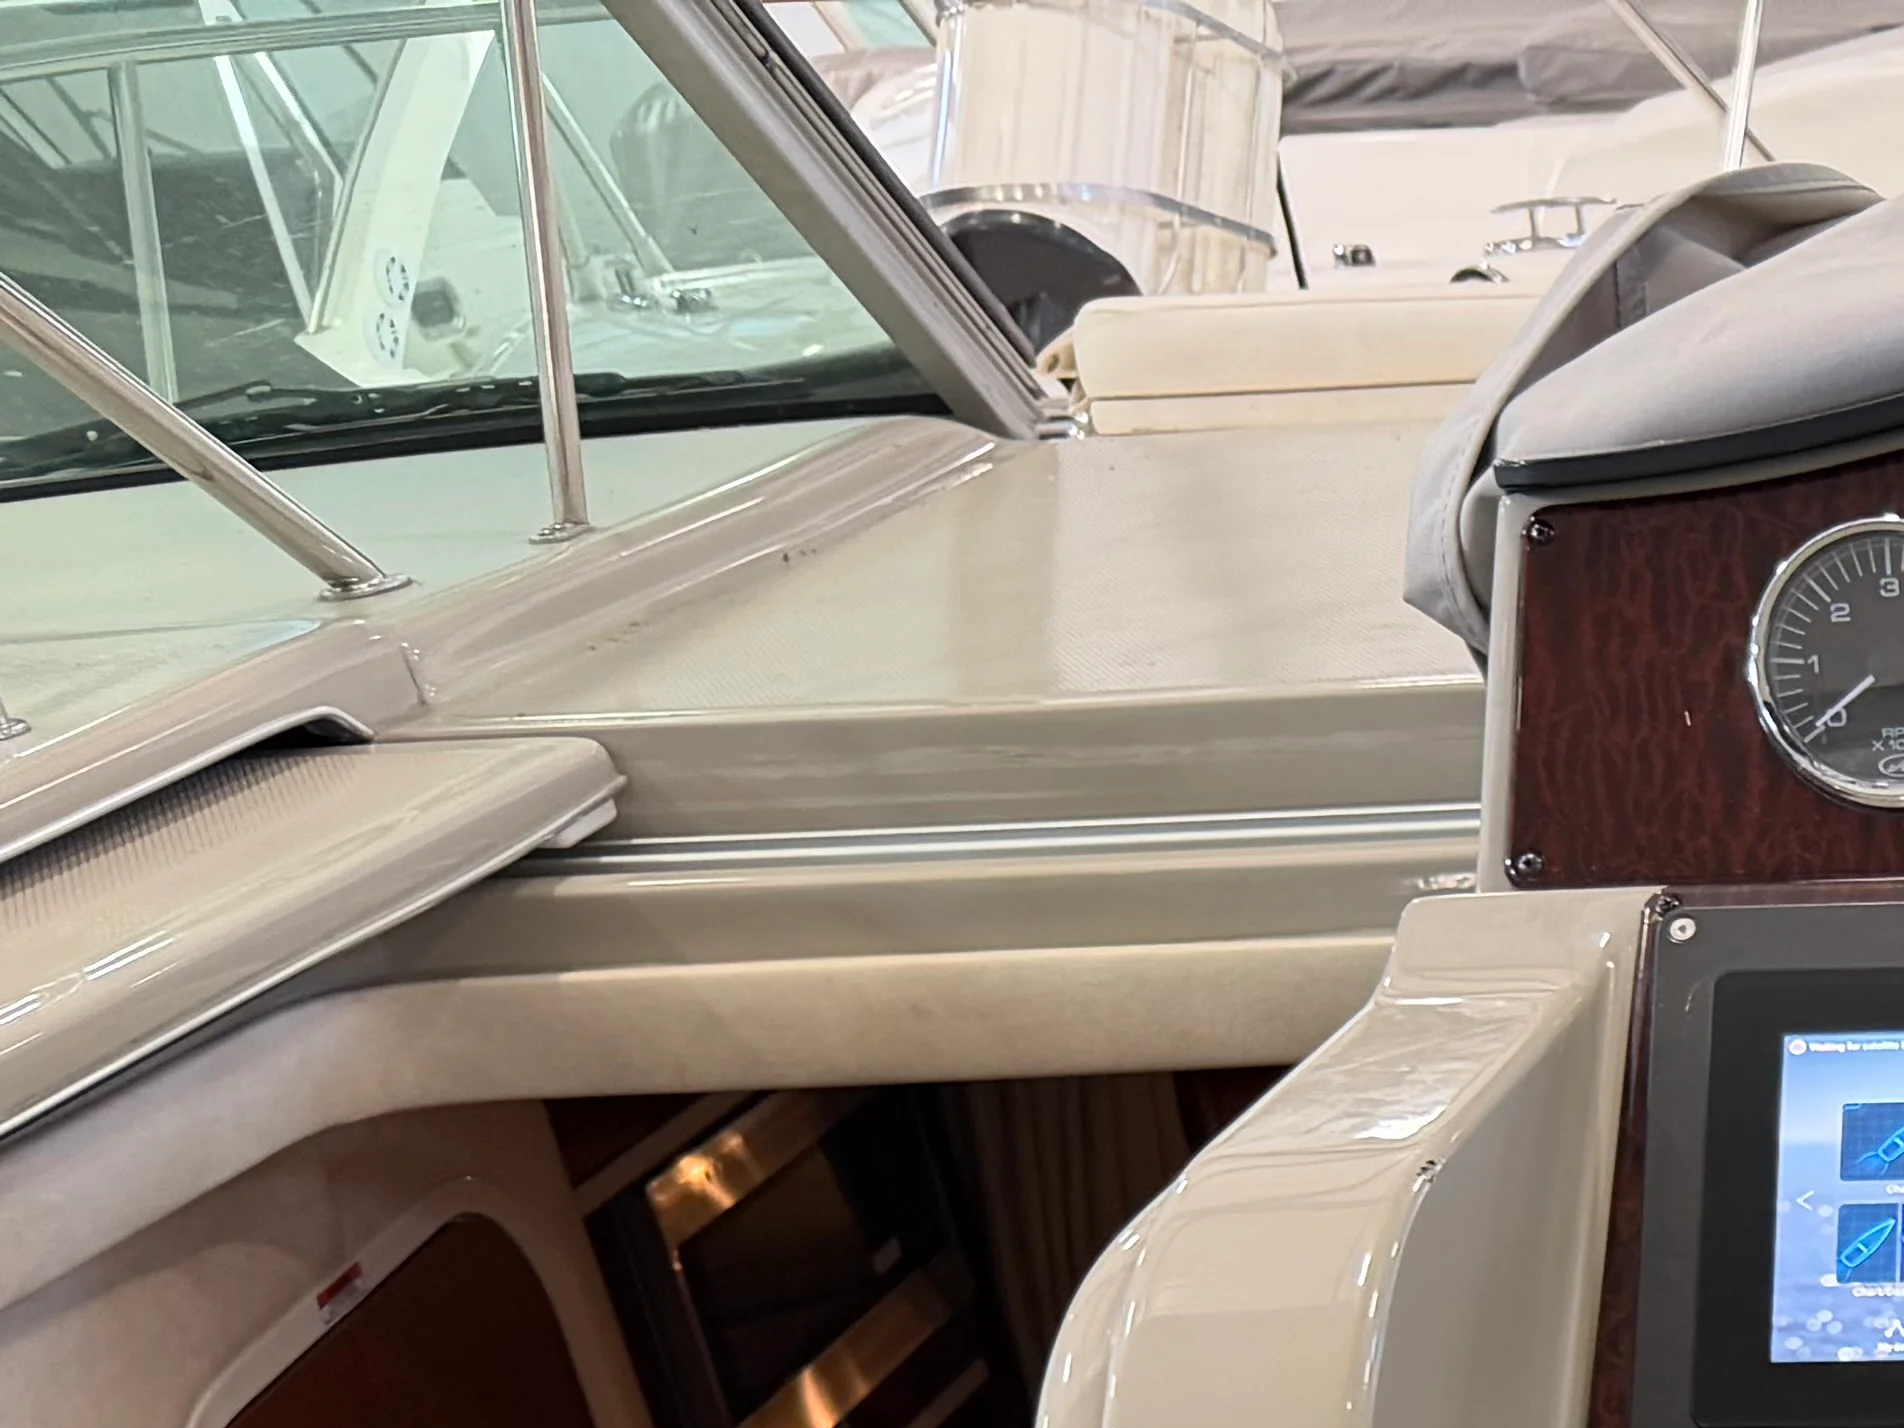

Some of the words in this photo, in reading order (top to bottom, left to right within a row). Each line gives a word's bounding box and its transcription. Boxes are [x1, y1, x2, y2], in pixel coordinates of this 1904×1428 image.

[1879, 577, 1900, 597] 3
[1830, 603, 1850, 622] 2
[1807, 655, 1819, 673] 1
[1872, 740, 1884, 751] X
